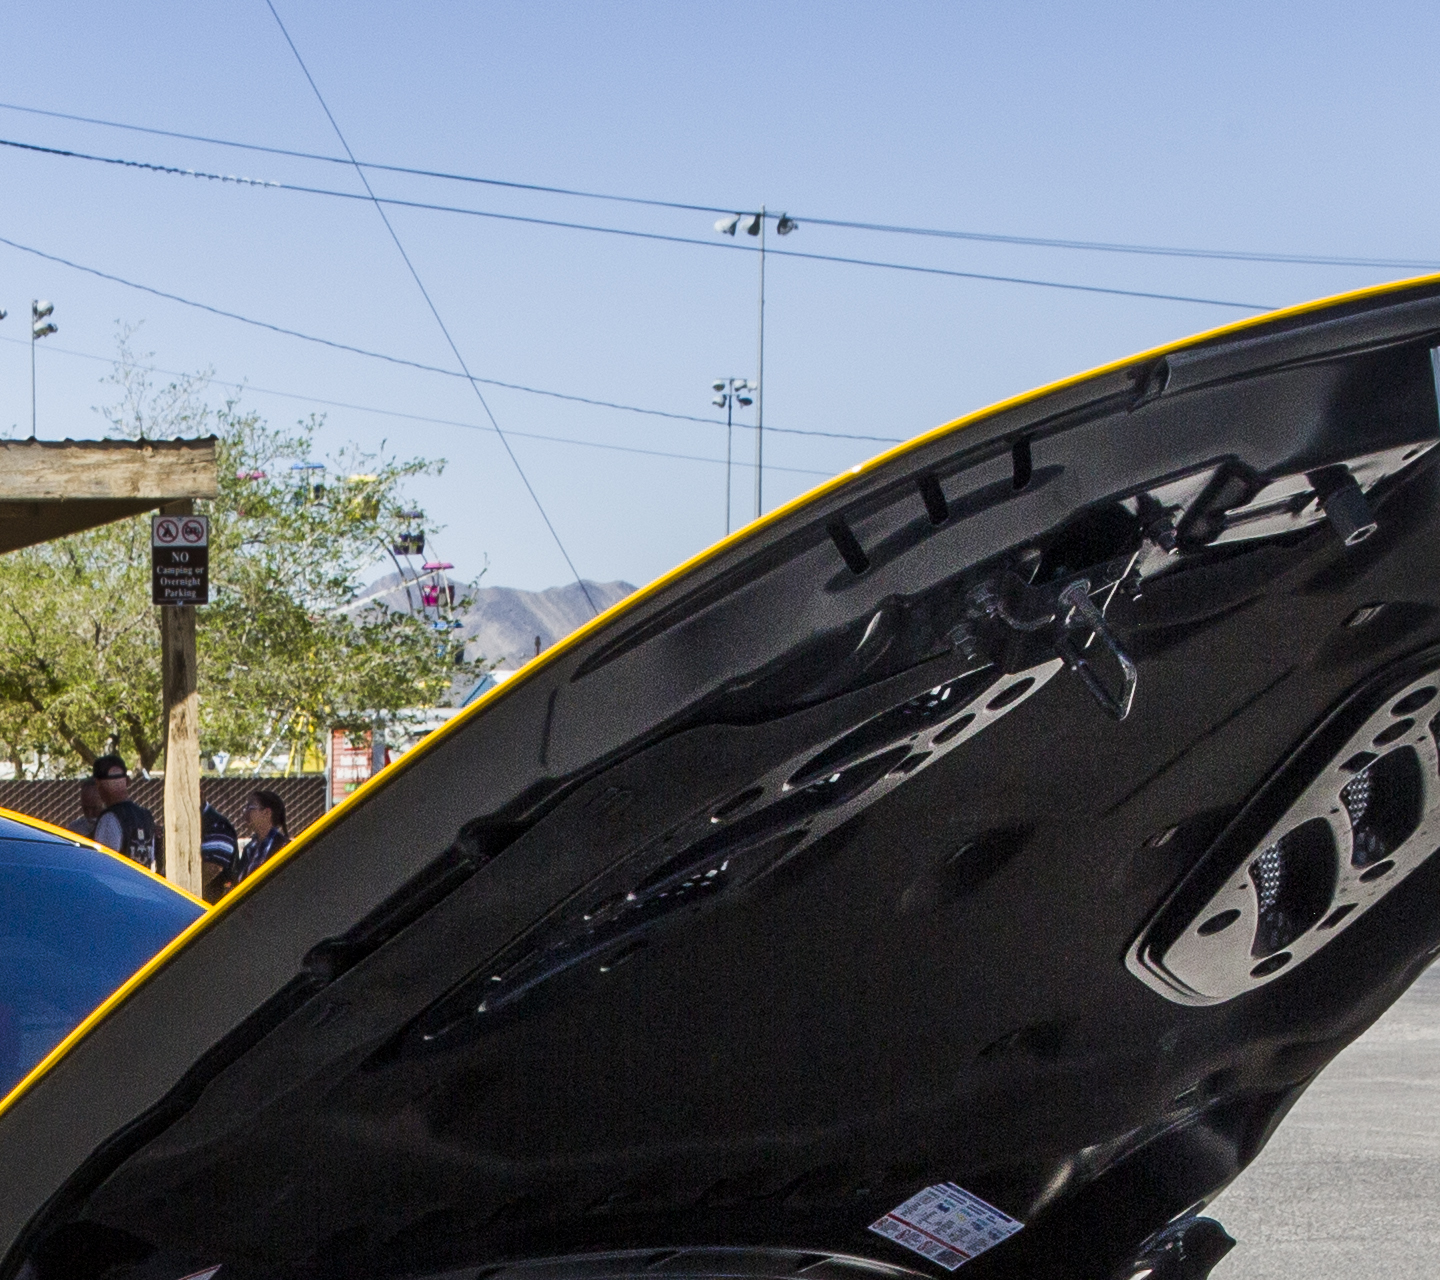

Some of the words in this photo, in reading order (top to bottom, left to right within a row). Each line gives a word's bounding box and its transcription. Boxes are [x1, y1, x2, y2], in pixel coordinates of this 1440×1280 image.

[171, 551, 189, 563] NO
[156, 565, 193, 577] Camping
[194, 567, 204, 575] or
[160, 576, 201, 588] Overnight
[164, 588, 197, 599] Parking
